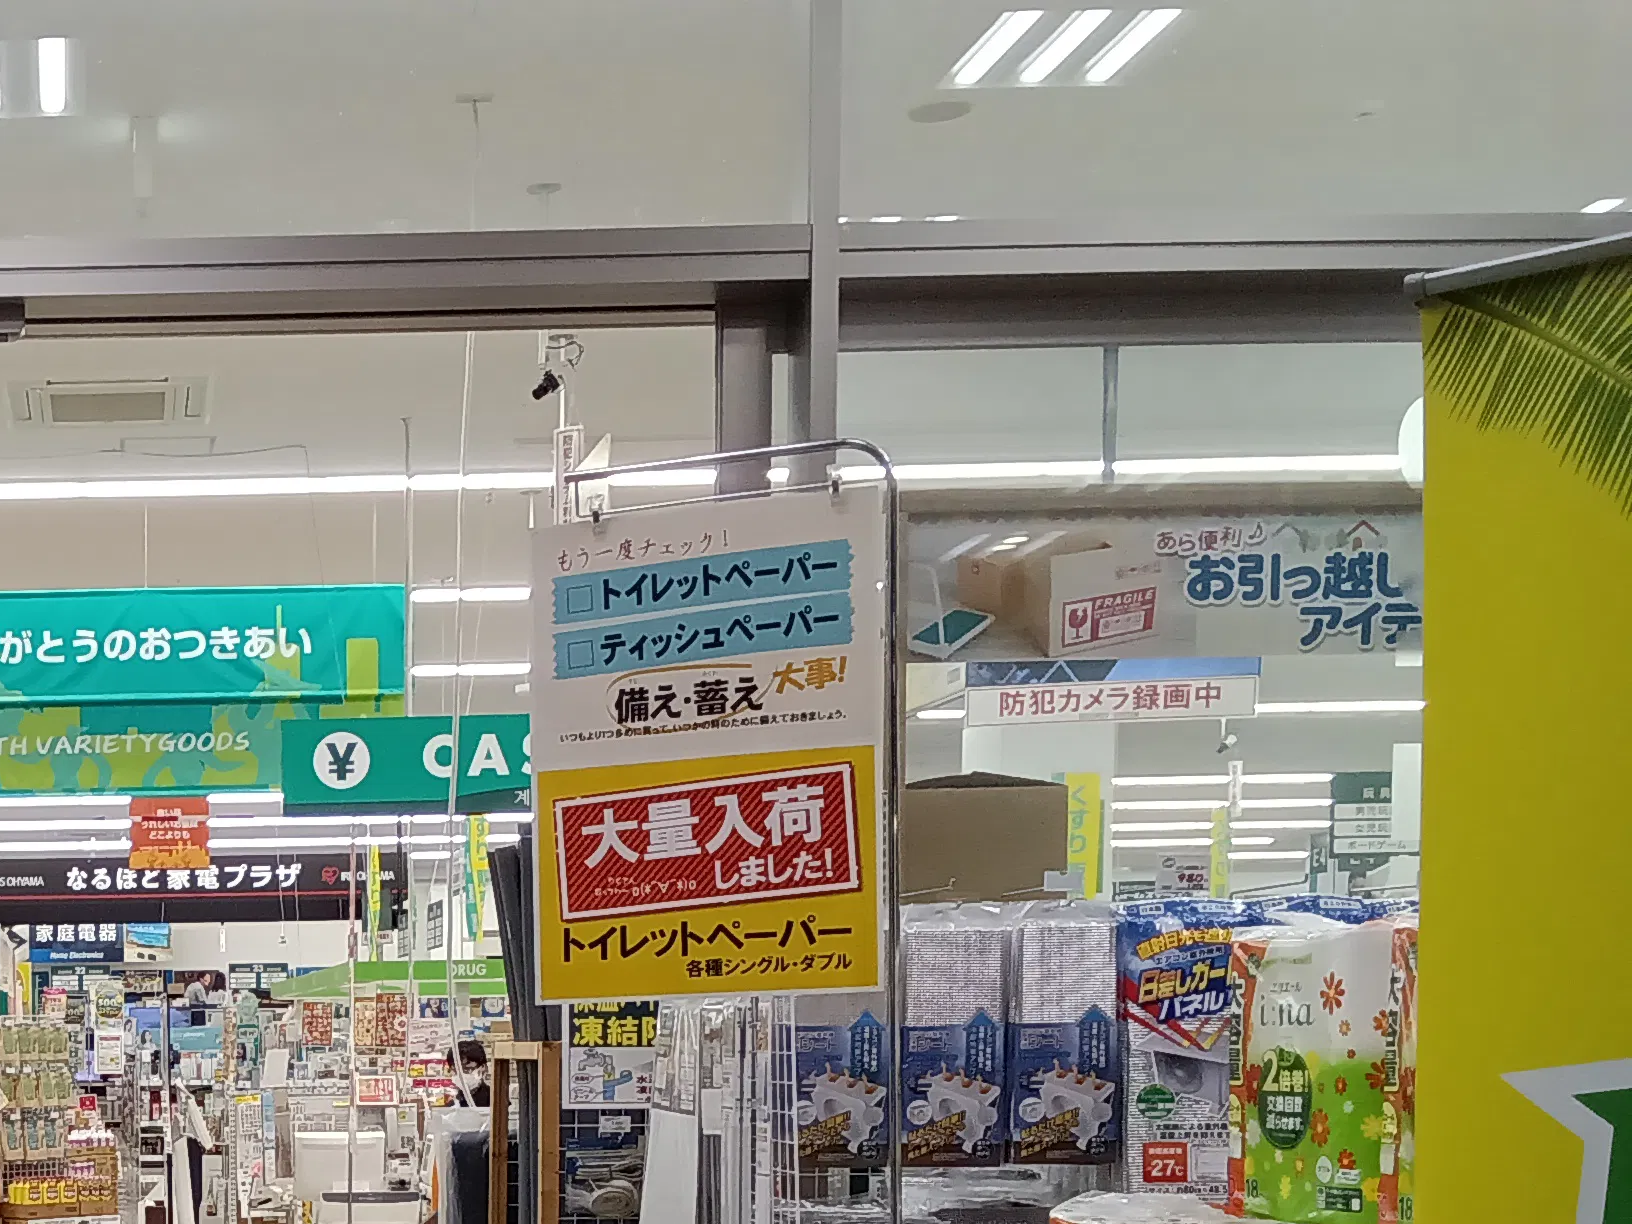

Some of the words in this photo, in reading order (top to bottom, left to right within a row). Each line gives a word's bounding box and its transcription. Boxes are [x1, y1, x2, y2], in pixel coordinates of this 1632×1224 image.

[557, 528, 729, 572] もう一度チェック!
[601, 551, 838, 610] トイレットペーパー
[1095, 588, 1155, 609] FRAGILE
[1186, 551, 1404, 602] お引っ越し
[600, 603, 841, 667] ティッシュペーパー
[1299, 602, 1422, 647] アイテ
[614, 676, 764, 724] 備え・蓄え
[998, 682, 1223, 718] 防犯カメラ録画中
[149, 830, 190, 839] どこよりも
[584, 782, 825, 869] 大量入荷
[7, 876, 45, 887] OHYAMA
[67, 863, 302, 891] なるほど家電プラザ
[35, 924, 117, 942] 家庭電器
[563, 914, 854, 962] トイレットペーパー
[686, 951, 852, 979] 各種シングル・ダブル
[1139, 957, 1232, 1002] 日差しガー
[1159, 989, 1231, 1021] パネル
